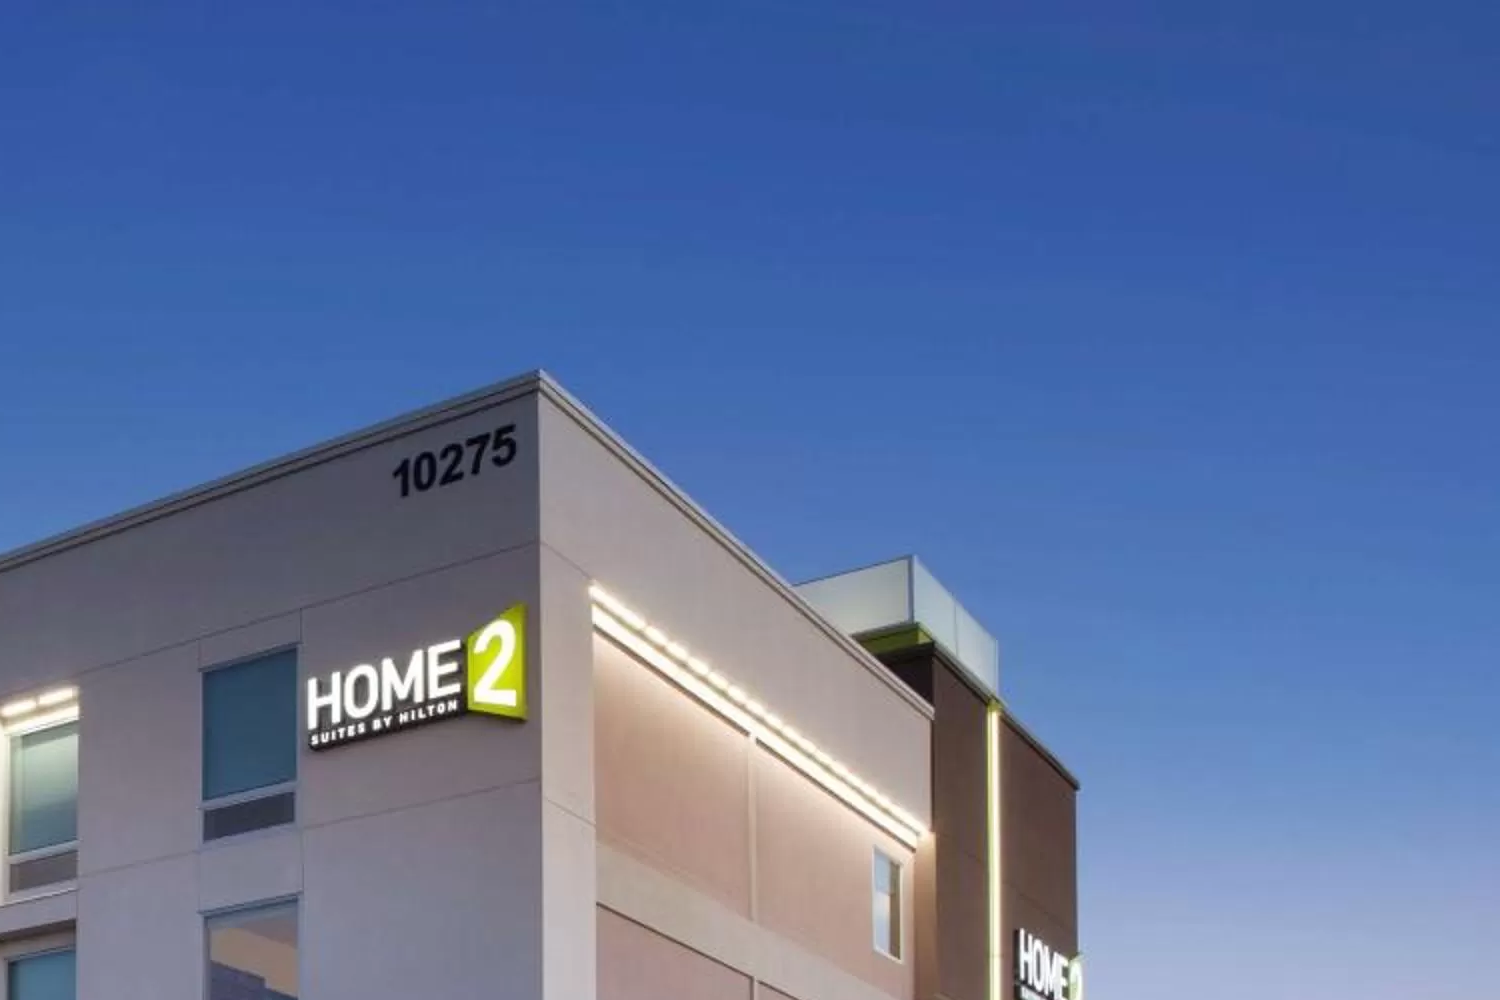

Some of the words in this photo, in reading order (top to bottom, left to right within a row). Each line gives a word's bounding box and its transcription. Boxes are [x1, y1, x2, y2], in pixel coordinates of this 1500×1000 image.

[393, 423, 517, 499] 10275
[311, 721, 367, 746] SUITES
[373, 714, 393, 731] BY
[399, 699, 458, 725] HILTON
